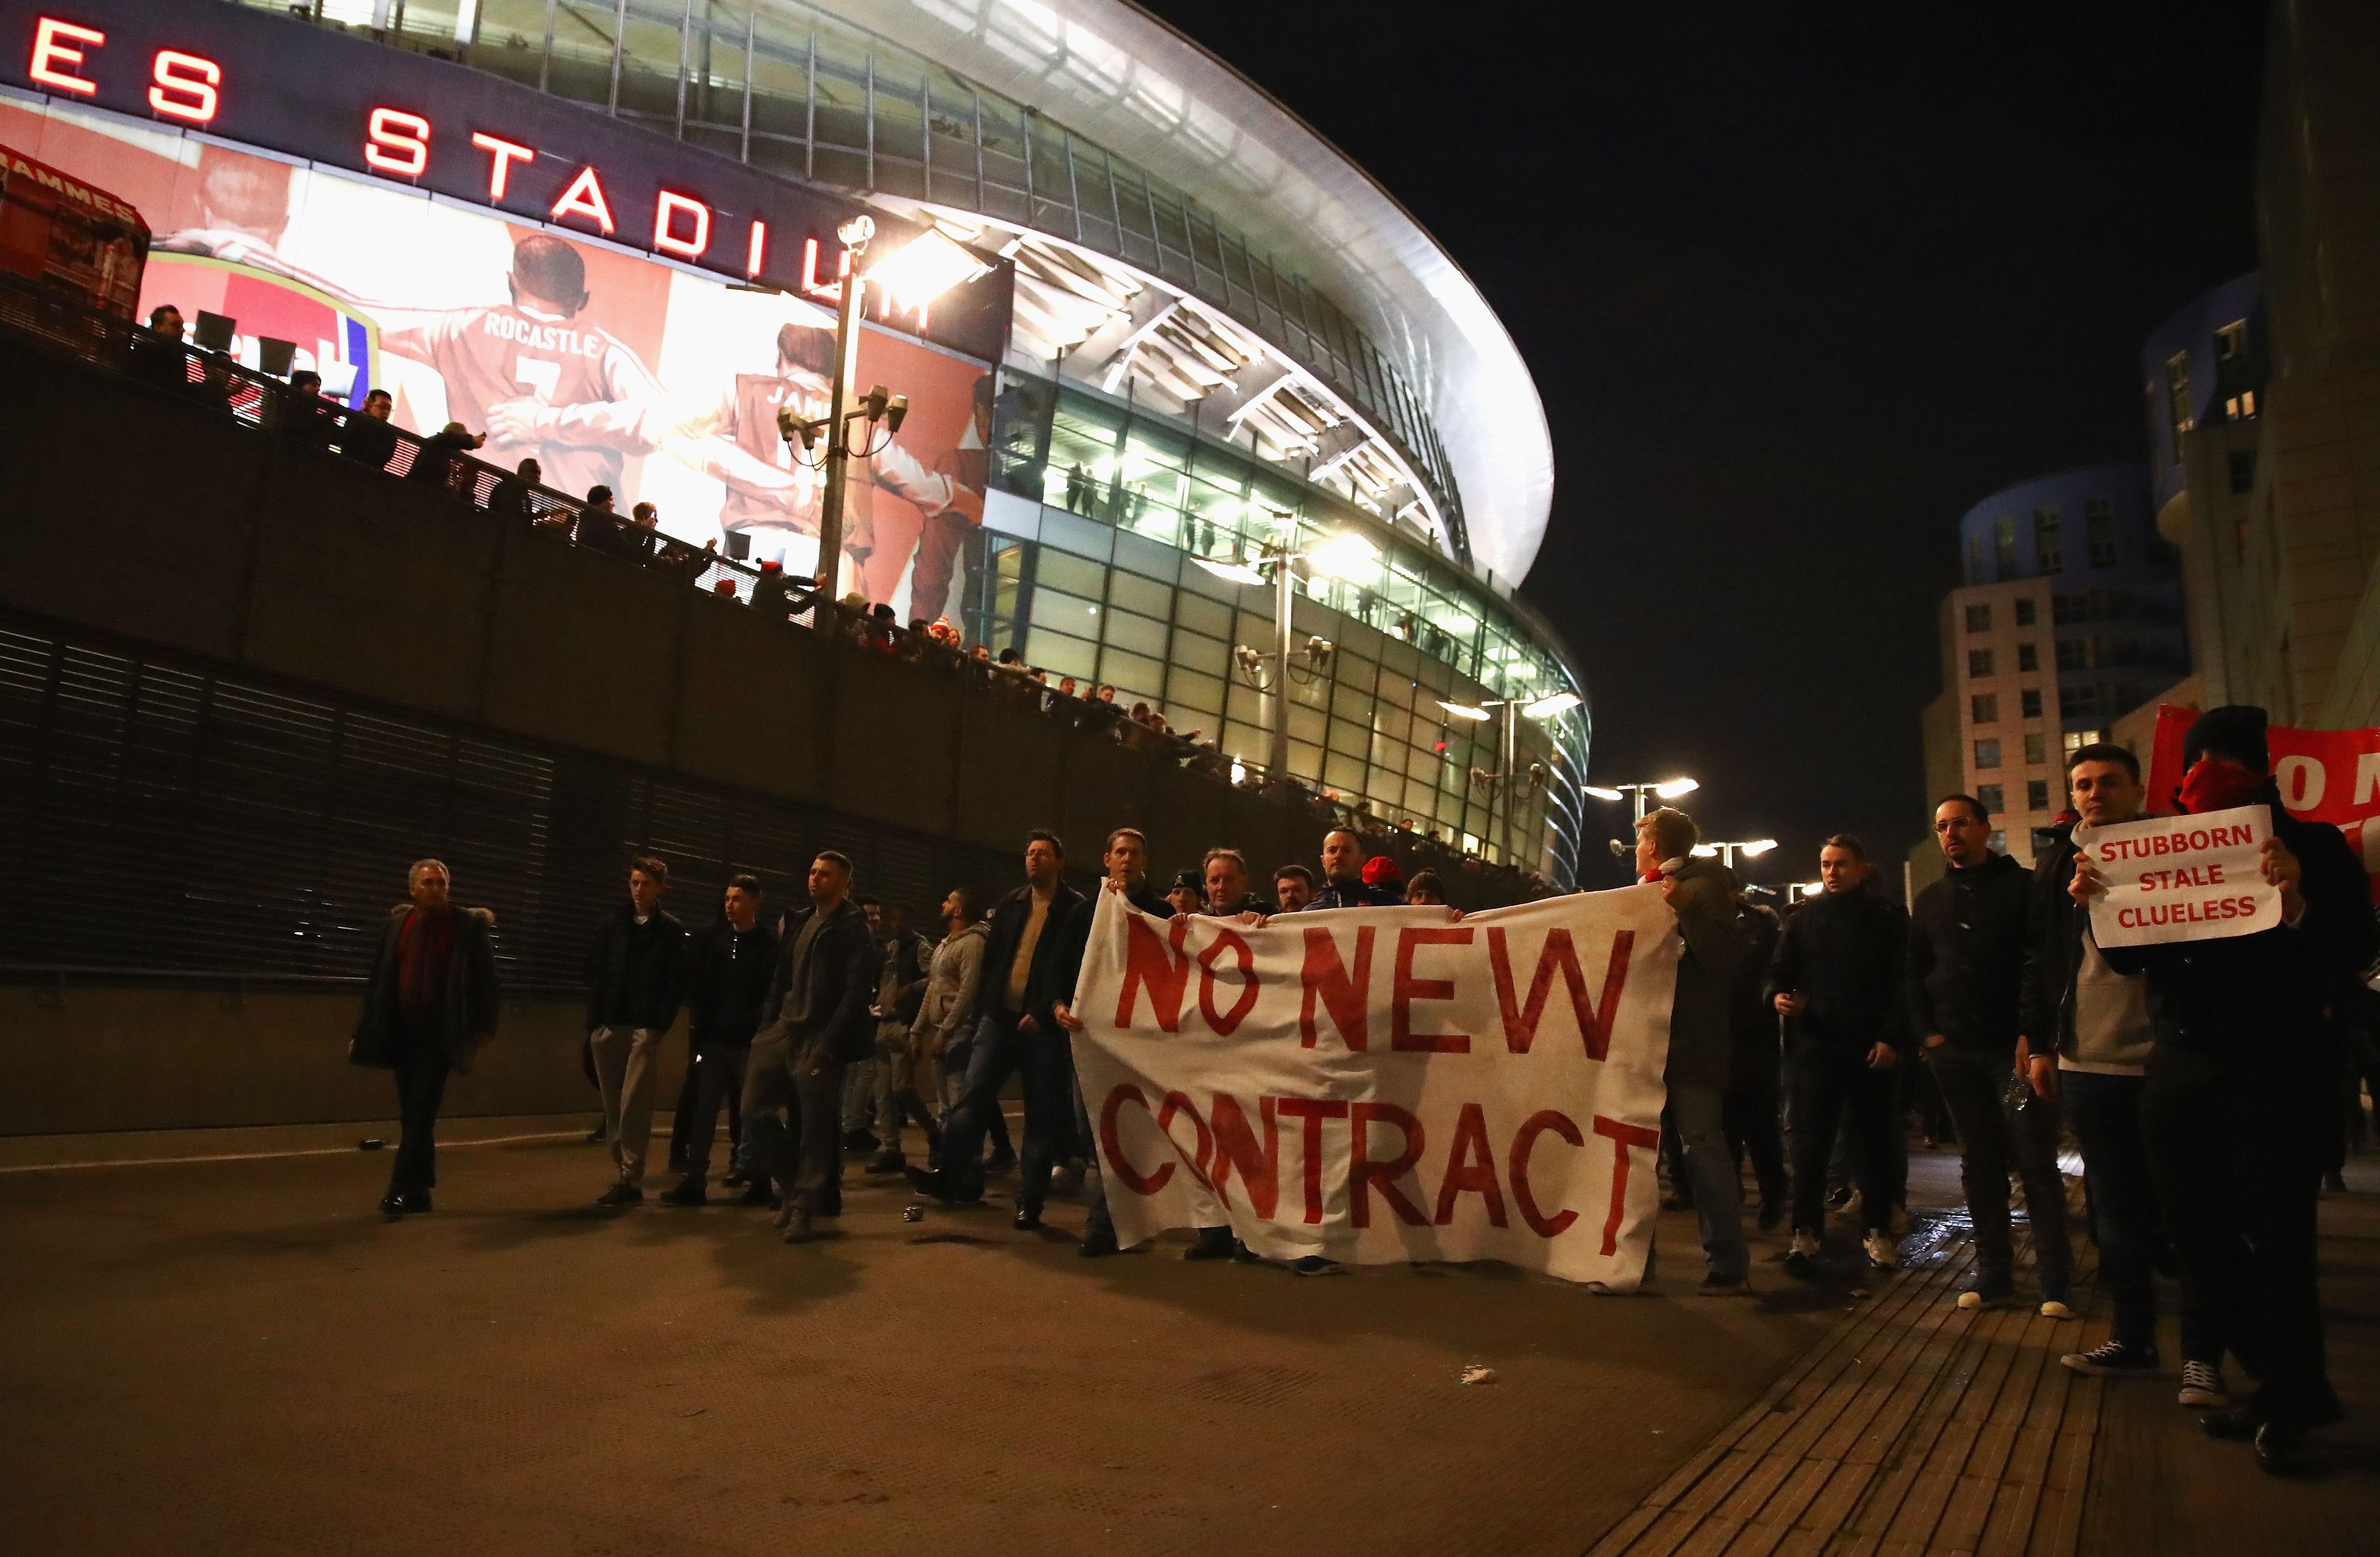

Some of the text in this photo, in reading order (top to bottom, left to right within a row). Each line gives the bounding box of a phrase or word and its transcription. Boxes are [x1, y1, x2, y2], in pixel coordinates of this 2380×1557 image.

[484, 312, 599, 359] ROCASTLE
[515, 355, 561, 400] 7
[2100, 824, 2253, 862] STUBBORN
[2139, 864, 2225, 892] STALE
[2118, 896, 2256, 929] CLUELESS
[1115, 913, 1635, 1062] NO NEW
[1100, 1083, 1659, 1256] CONTRACT
